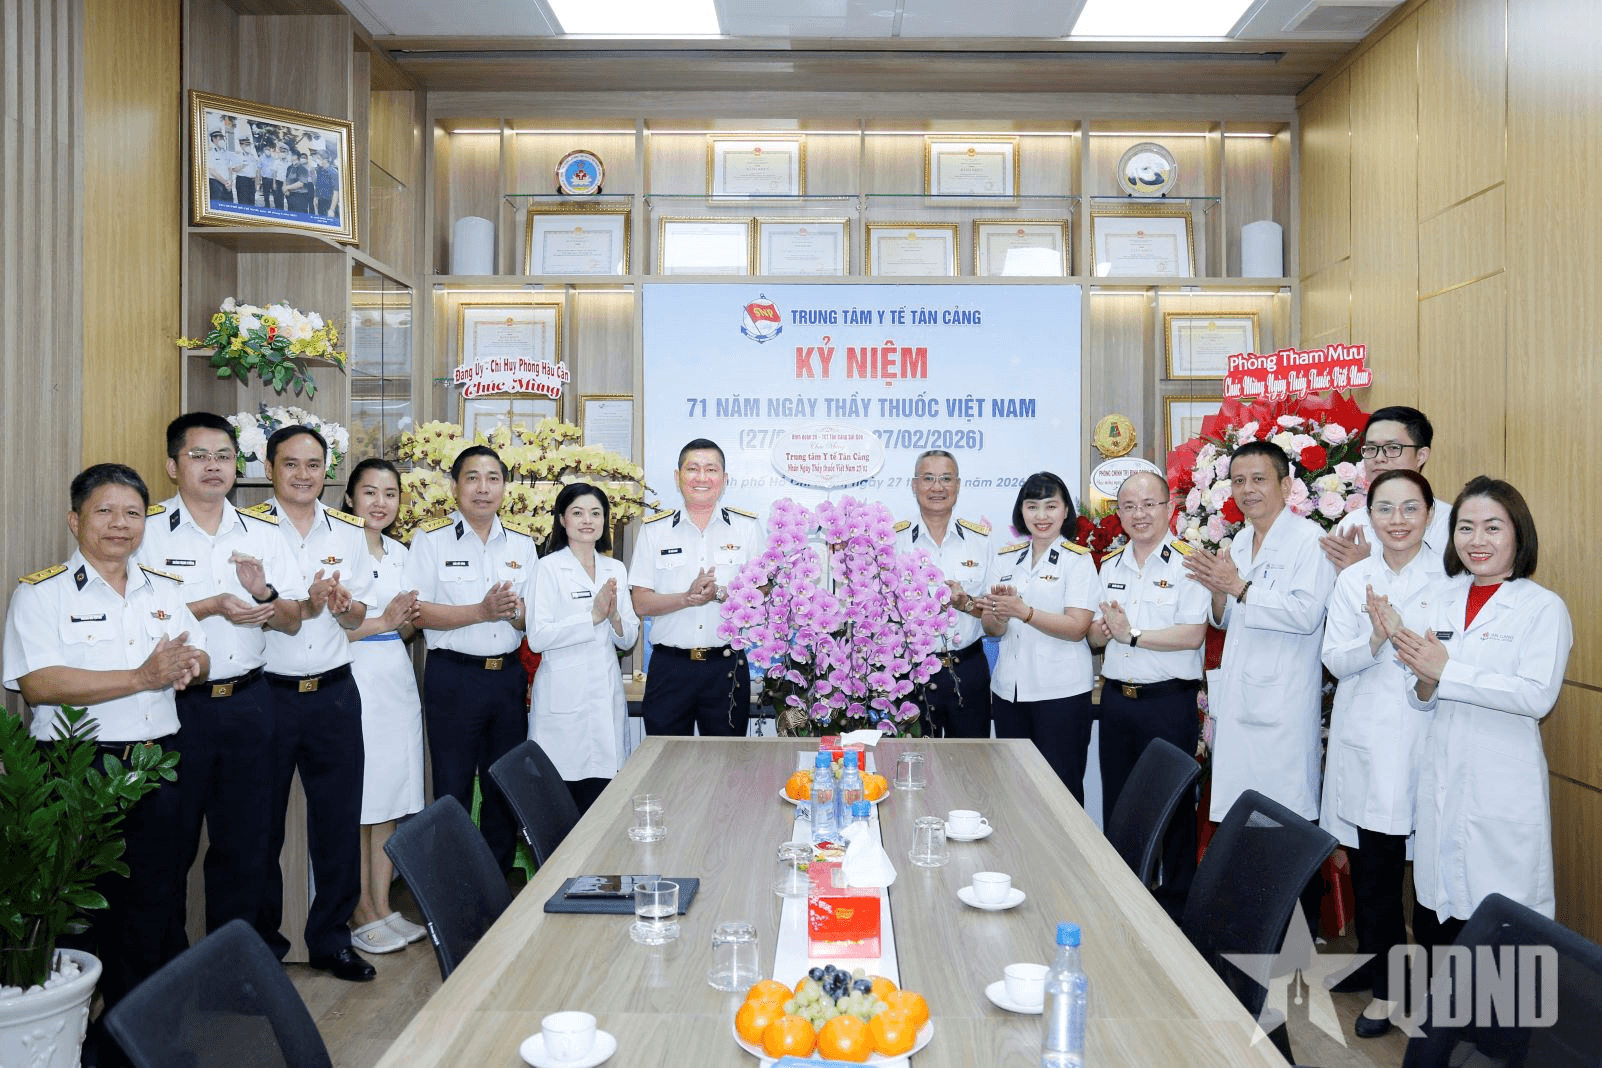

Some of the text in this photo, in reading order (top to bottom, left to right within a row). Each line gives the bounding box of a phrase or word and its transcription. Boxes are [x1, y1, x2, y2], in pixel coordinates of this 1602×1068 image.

[791, 305, 982, 325] TRUNG TÂM Y TẾ TÂN CẢNG
[455, 366, 473, 382] Đảng
[475, 358, 484, 378] Ủy
[504, 358, 517, 375] Huy
[519, 358, 539, 377] Phòng
[542, 361, 555, 380] Hậu
[795, 335, 928, 387] KỶ NIỆM
[1230, 345, 1364, 372] Phòng Tham Mưu
[464, 380, 505, 397] Chúc
[1225, 377, 1241, 397] Chúc
[1267, 373, 1287, 400] Ngày
[1309, 367, 1331, 390] Thuốc
[1332, 366, 1348, 391] Việt
[1350, 365, 1369, 385] Nam
[687, 391, 1036, 422] 71 NĂM NGÀY THẦY THUỐC VIỆT NAM
[786, 451, 870, 462] Trung tâm Y tế Tân Cảng
[887, 477, 902, 488] 27
[965, 476, 993, 488] năm
[995, 477, 1025, 488] 2026
